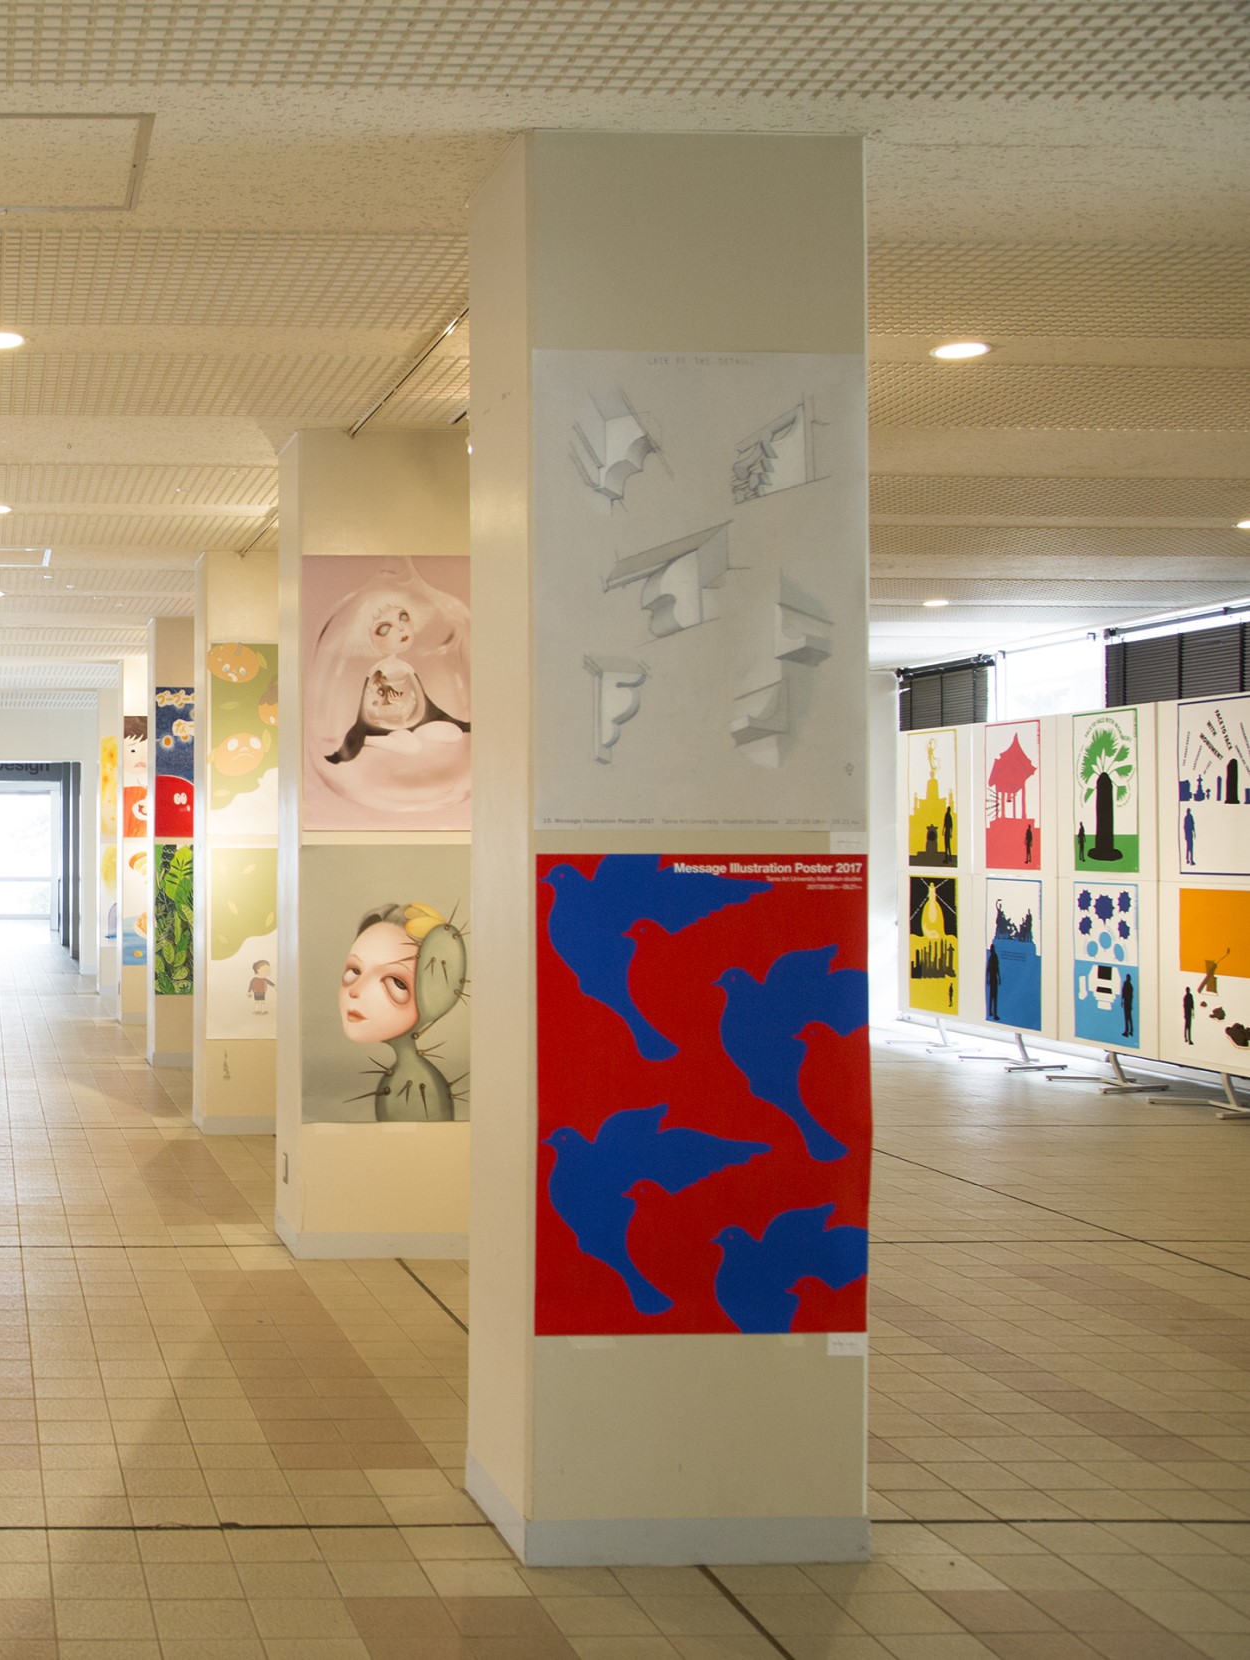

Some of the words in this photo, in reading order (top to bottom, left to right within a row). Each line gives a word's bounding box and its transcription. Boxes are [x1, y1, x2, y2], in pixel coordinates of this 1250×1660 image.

[673, 862, 727, 875] Message
[729, 862, 793, 873] Illustration
[795, 862, 833, 874] Poster
[835, 862, 862, 874] 2017
